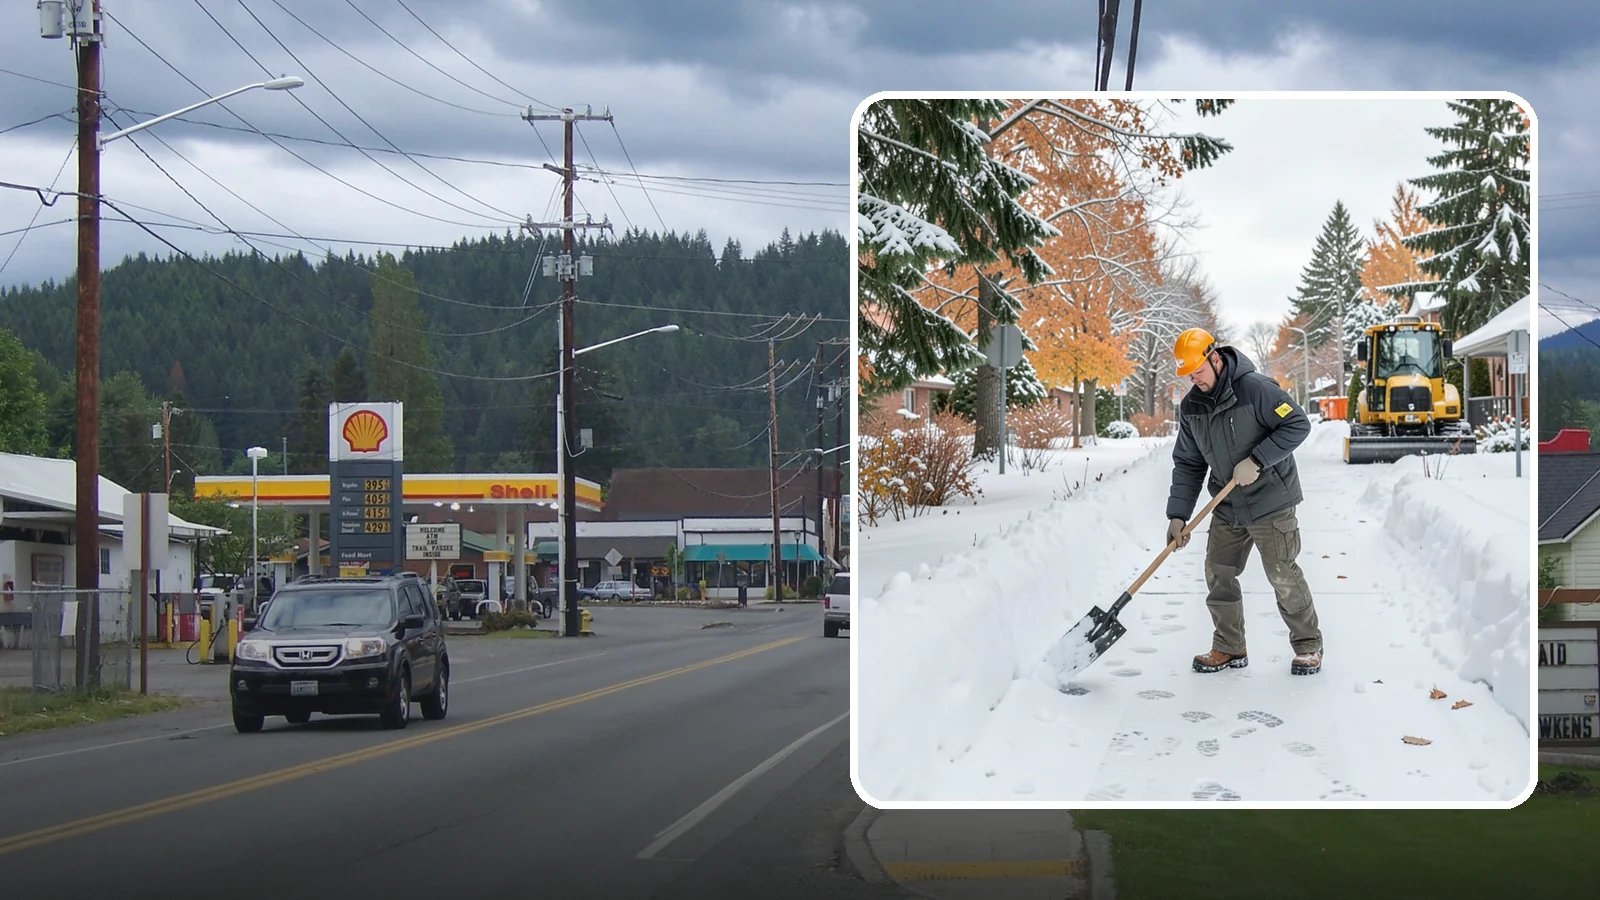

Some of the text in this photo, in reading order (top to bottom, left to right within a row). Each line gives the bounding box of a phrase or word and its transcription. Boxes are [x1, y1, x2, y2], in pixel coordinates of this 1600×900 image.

[365, 480, 384, 490] 395
[490, 484, 547, 499] Shell
[365, 494, 384, 504] 405
[365, 508, 384, 518] 415
[366, 522, 384, 532] 429
